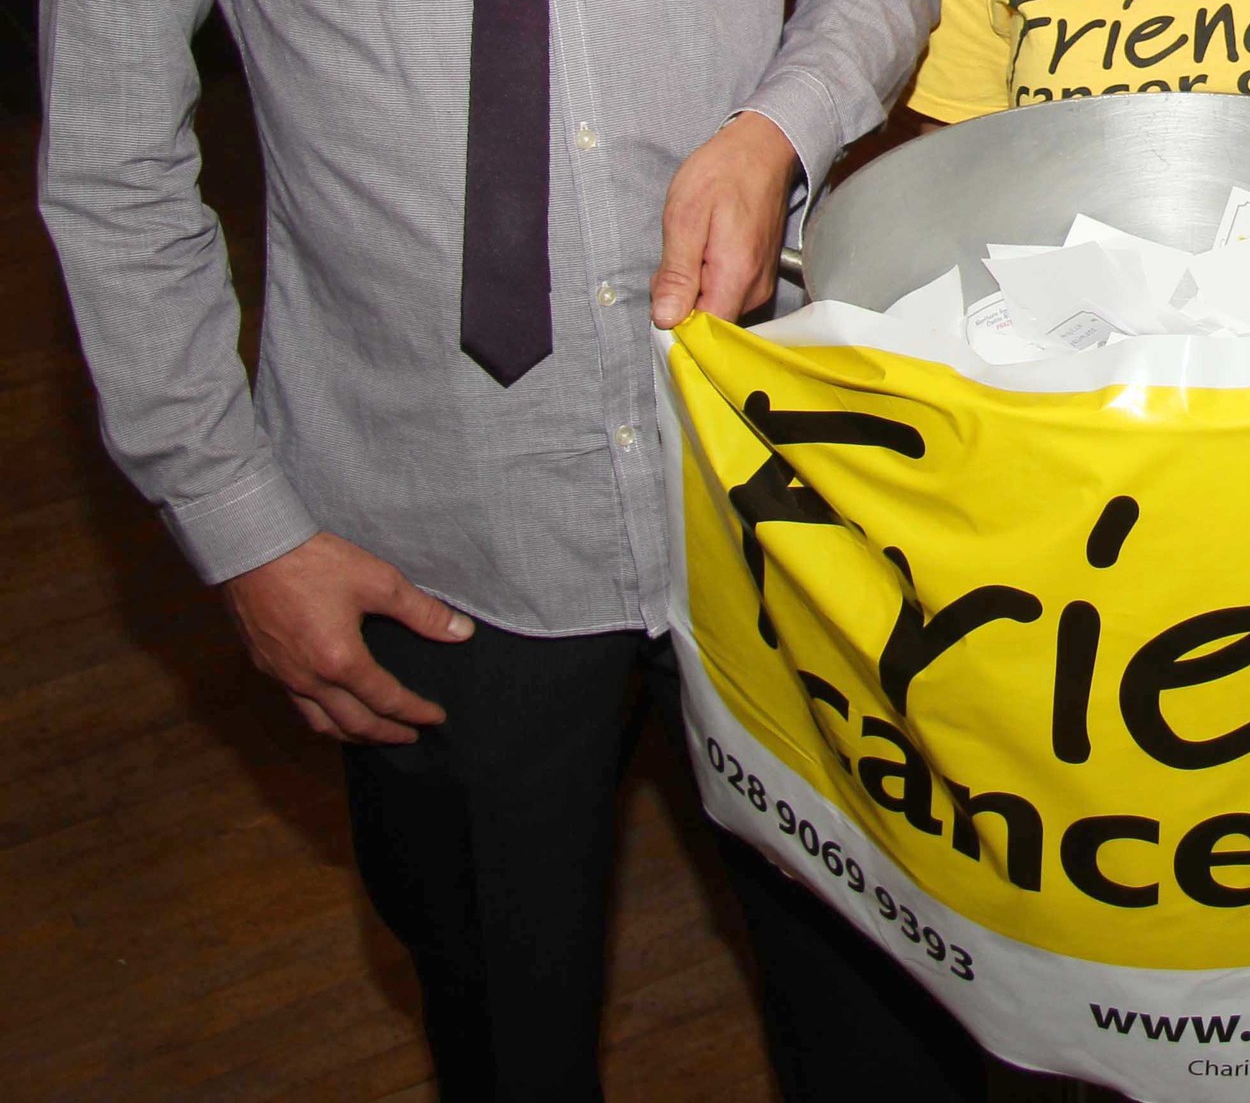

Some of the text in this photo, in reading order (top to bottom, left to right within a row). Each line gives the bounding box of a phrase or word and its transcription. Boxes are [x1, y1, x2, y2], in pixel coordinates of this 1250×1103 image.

[706, 736, 974, 981] 028 9069 9393
